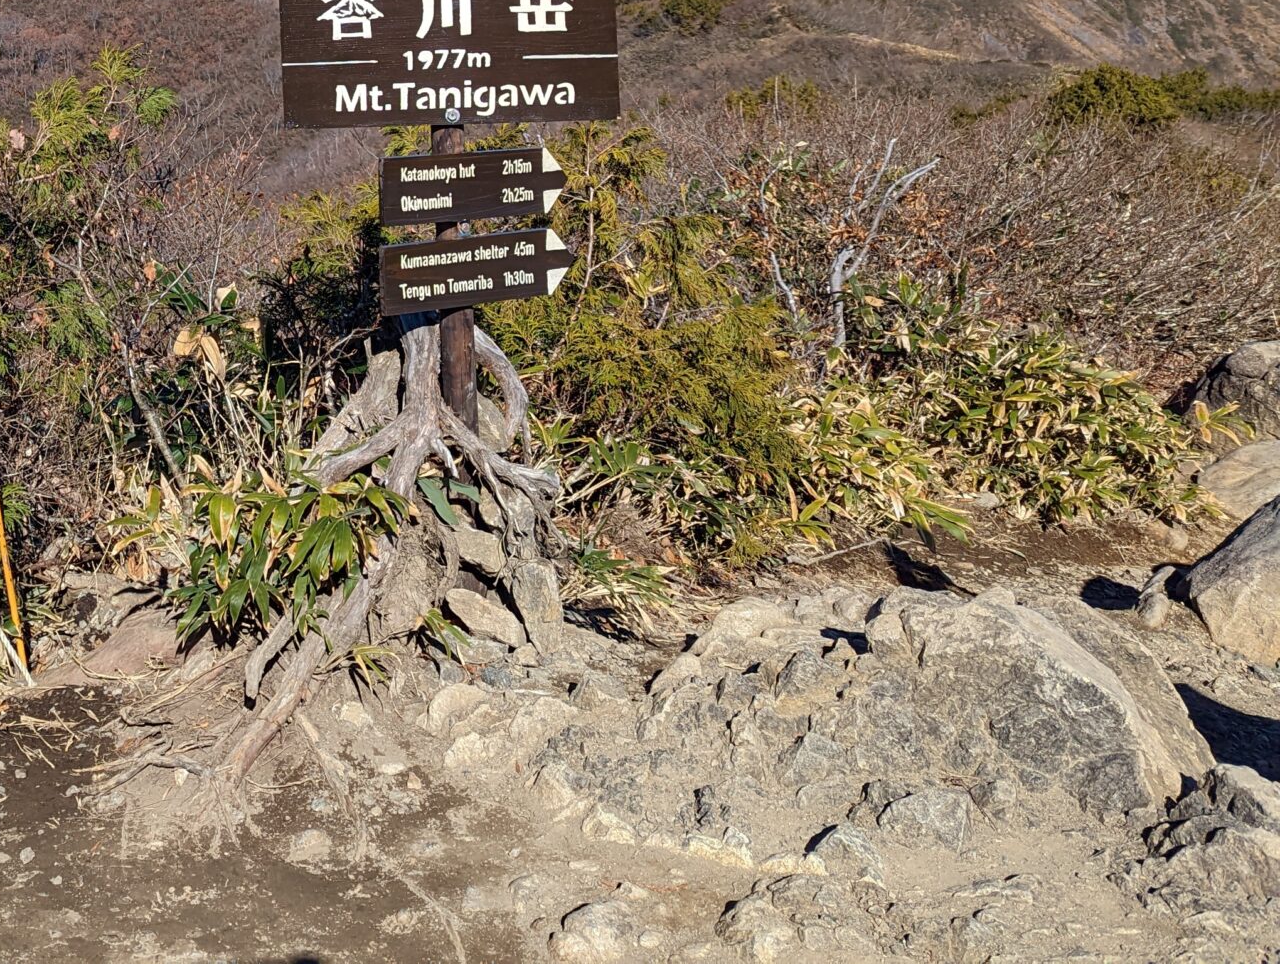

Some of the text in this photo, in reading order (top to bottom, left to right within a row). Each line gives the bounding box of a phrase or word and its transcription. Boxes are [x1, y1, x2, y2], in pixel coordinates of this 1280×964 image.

[403, 49, 491, 71] 1977m
[400, 159, 532, 184] Katanokoya hut 2h15m
[401, 187, 534, 212] Okinomimi 2h25m
[400, 242, 535, 269] Kumaanazawa shelter 45m
[399, 270, 534, 301] Tengu no Tomariba 1h30m
